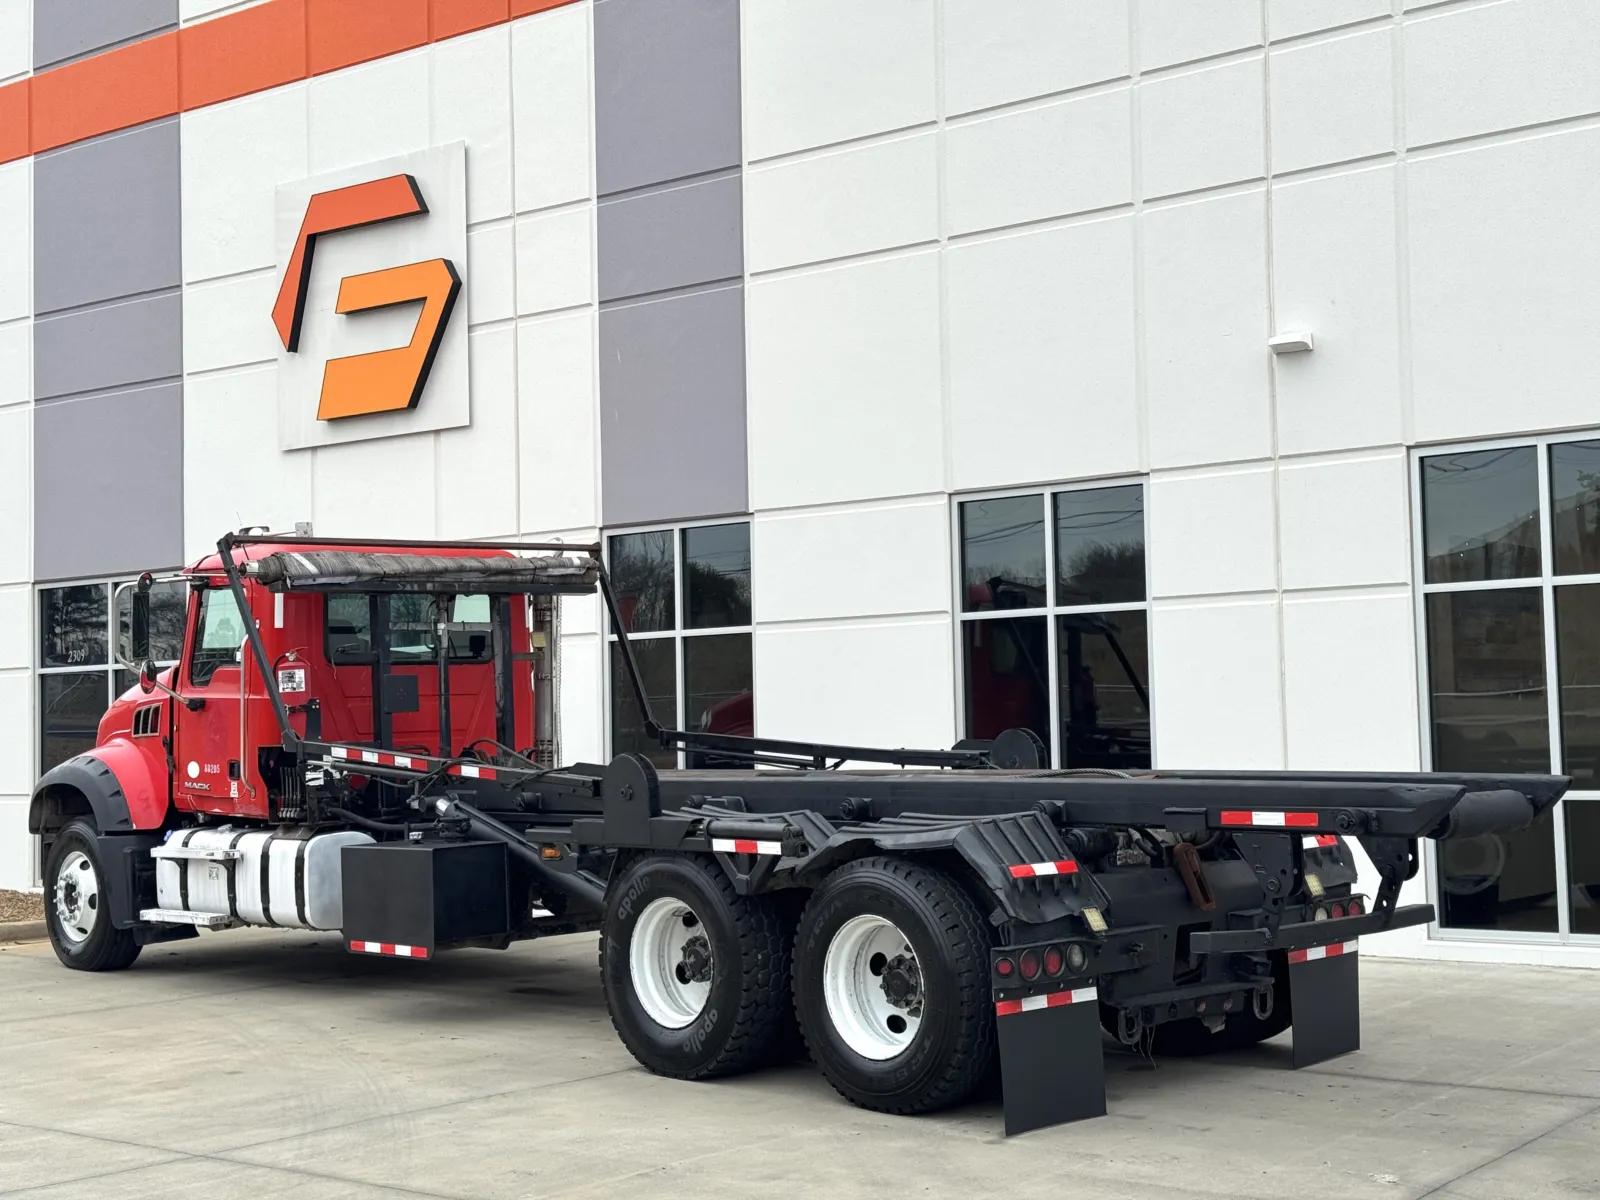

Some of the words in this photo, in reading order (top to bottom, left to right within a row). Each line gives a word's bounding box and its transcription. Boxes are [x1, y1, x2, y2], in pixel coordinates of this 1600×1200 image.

[67, 649, 85, 663] 2309
[184, 781, 211, 791] MACK
[617, 875, 650, 920] apollo
[683, 1009, 718, 1054] apollo
